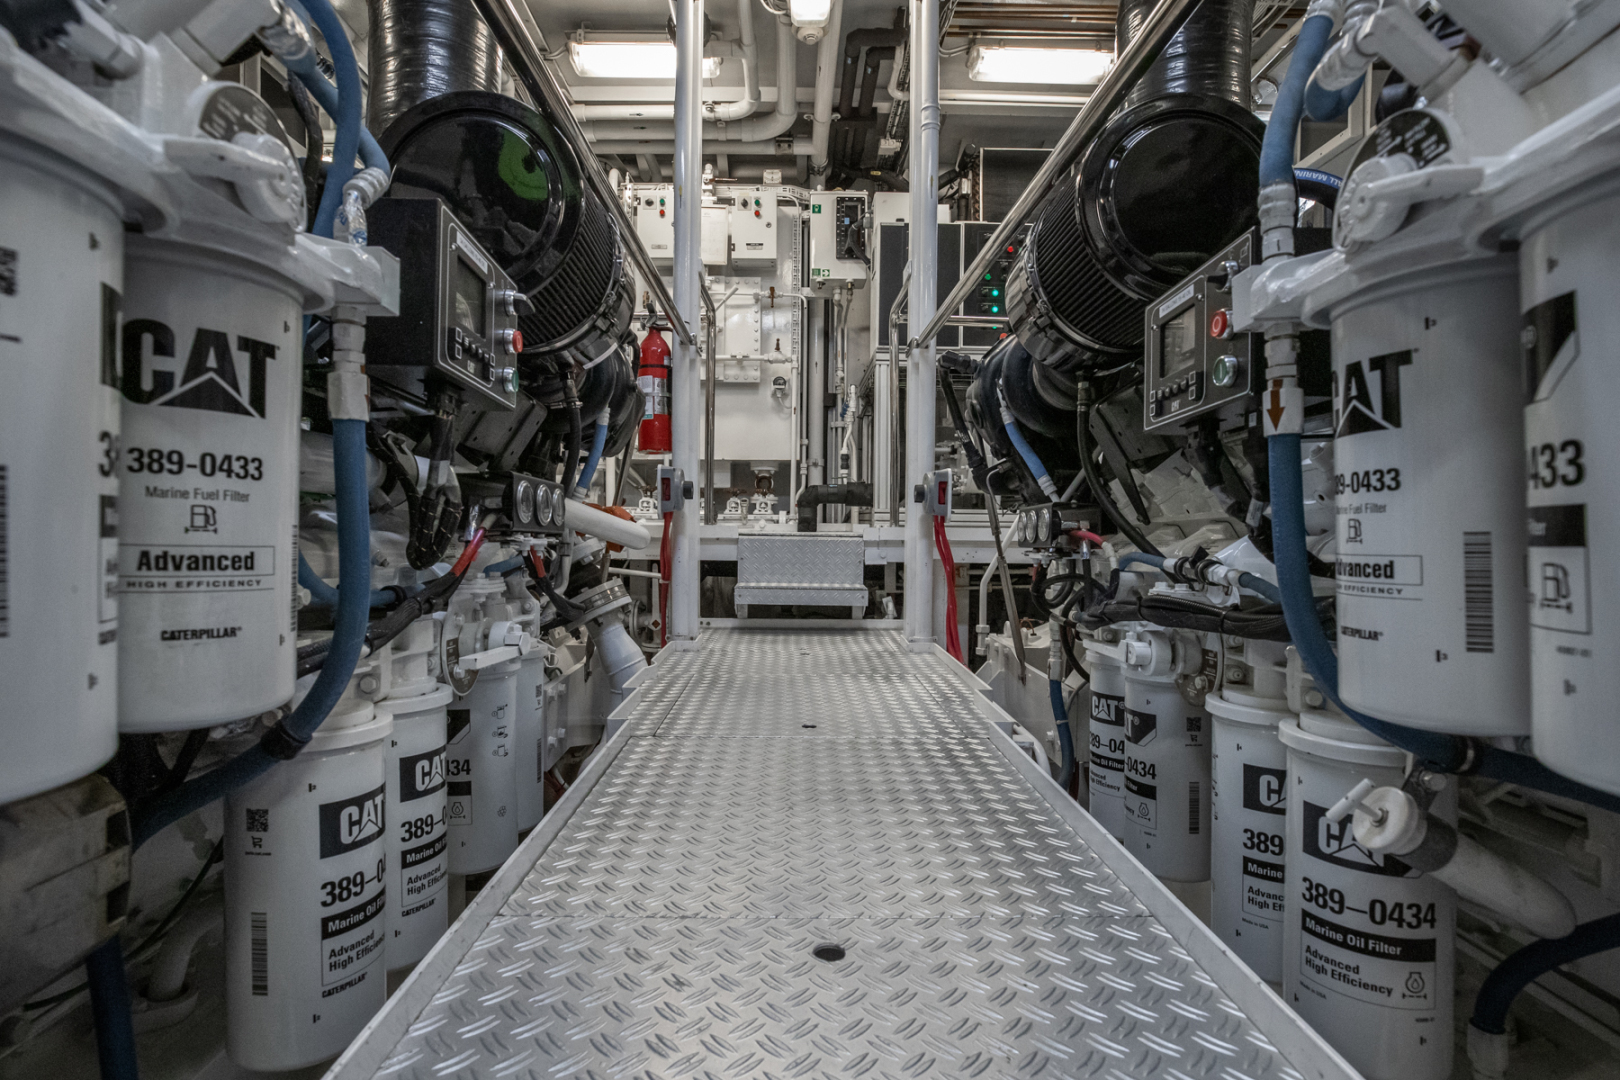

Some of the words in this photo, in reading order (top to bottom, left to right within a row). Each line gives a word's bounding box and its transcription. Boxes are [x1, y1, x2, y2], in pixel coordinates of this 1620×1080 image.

[1295, 170, 1328, 182] MARIN
[121, 318, 277, 419] CAT
[126, 447, 263, 481] 389-0433
[144, 485, 190, 500] Marine
[193, 487, 220, 501] Fuel
[223, 489, 251, 503] Filter
[1364, 502, 1387, 514] Filter
[136, 550, 255, 572] Advanced
[126, 580, 168, 588] HIGH
[174, 579, 263, 589] EFFICIENCY
[161, 626, 238, 642] CATERPILLAR
[1091, 695, 1119, 722] CAT
[340, 793, 384, 845] CAT
[406, 846, 434, 864] Marine
[407, 863, 441, 886] Advanced
[1247, 862, 1283, 879] Marine
[407, 882, 426, 896] High
[1247, 895, 1270, 910] High
[328, 911, 365, 933] Marine
[329, 930, 375, 960] Advanced
[1305, 917, 1344, 943] Marine
[1347, 932, 1366, 951] Oil
[1368, 937, 1402, 956] Filter
[329, 955, 354, 972] High
[1305, 945, 1360, 975] Advanced
[322, 974, 366, 998] CATERPILLAR
[1305, 956, 1329, 978] High
[1331, 968, 1394, 998] Efficiency
